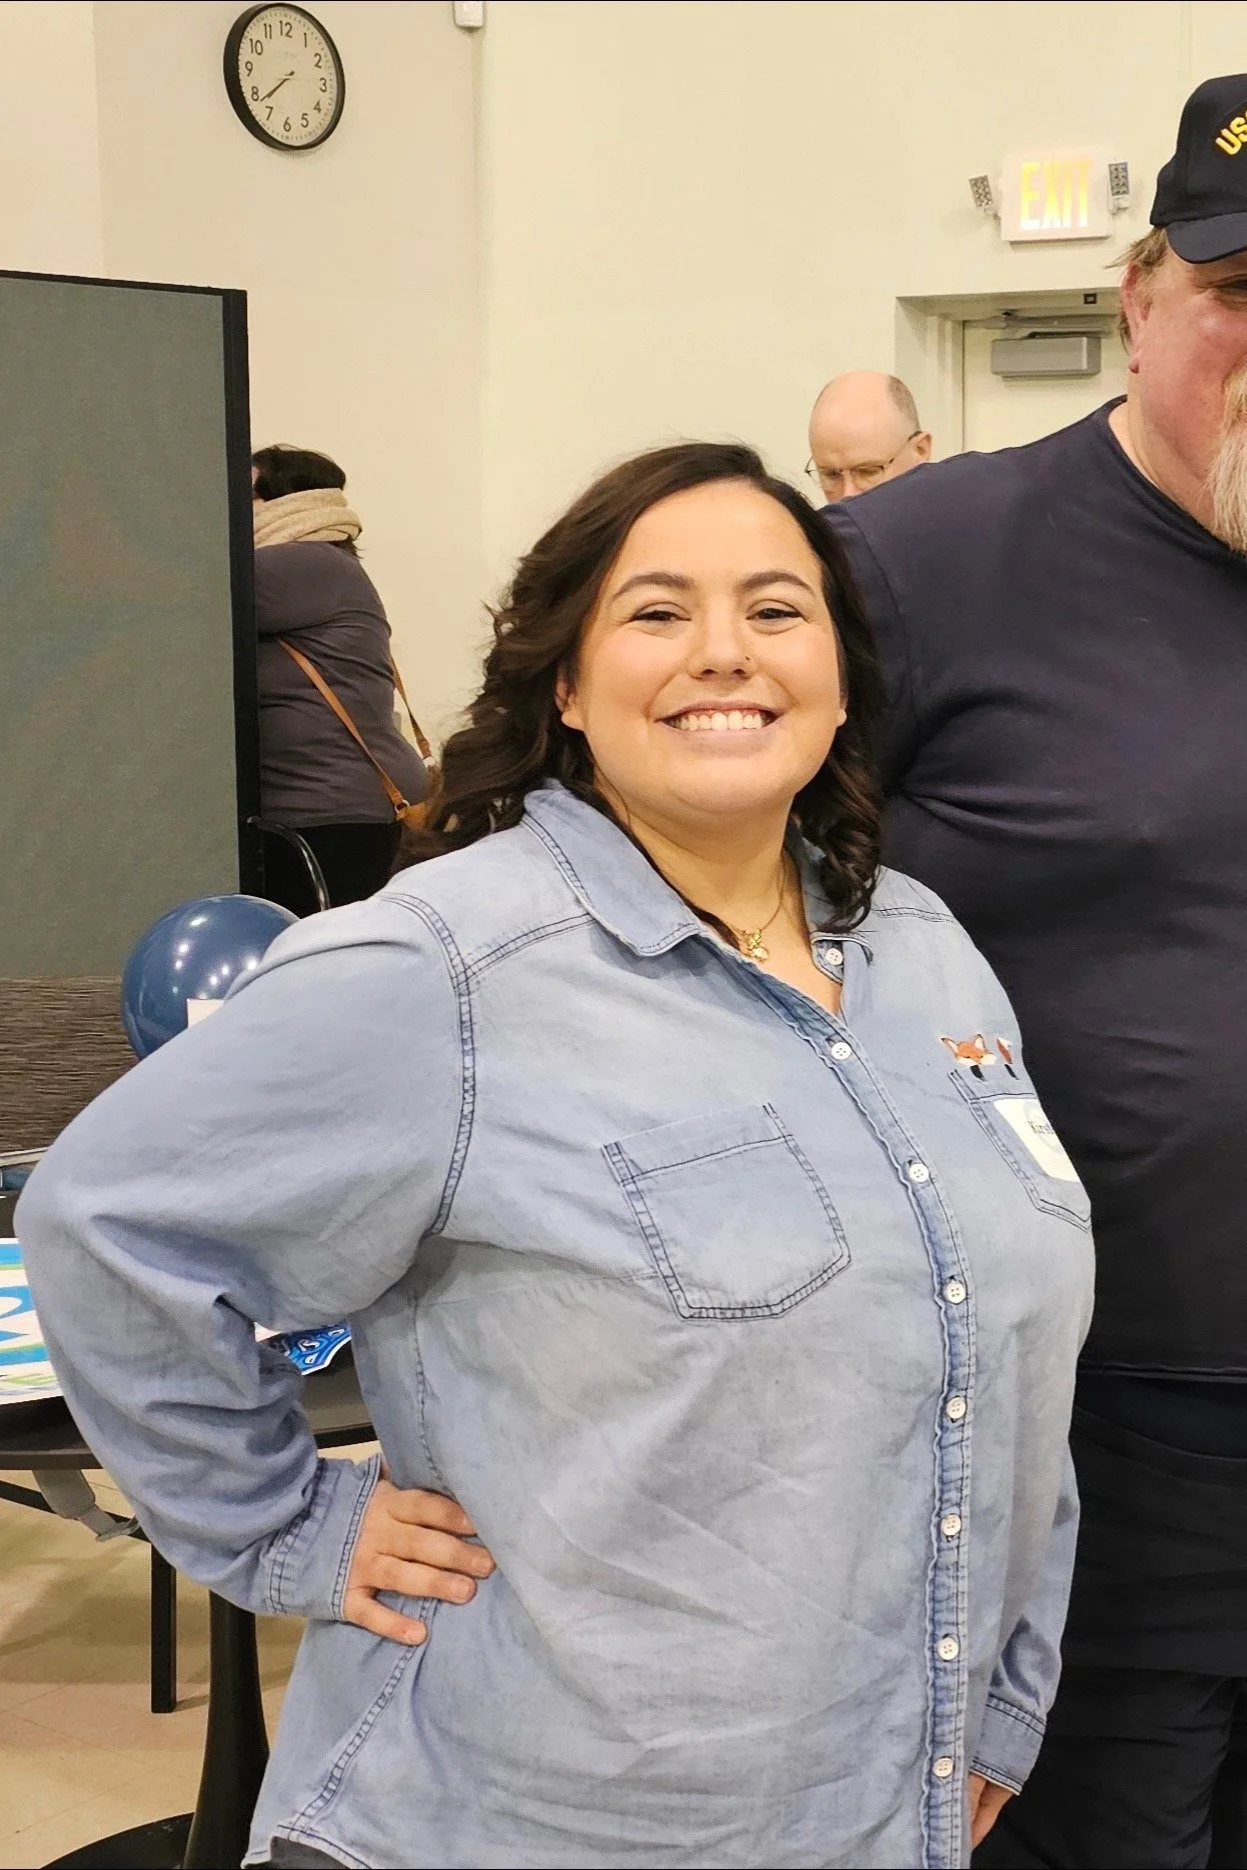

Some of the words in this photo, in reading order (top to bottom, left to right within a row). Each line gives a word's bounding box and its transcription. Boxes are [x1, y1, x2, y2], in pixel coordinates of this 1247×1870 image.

[263, 23, 272, 40] 11
[279, 20, 293, 38] 12
[249, 38, 263, 56] 10
[303, 32, 308, 48] 1
[314, 52, 322, 69] 2
[245, 61, 253, 77] 9
[319, 77, 327, 92] 3
[251, 86, 259, 102] 8
[265, 106, 274, 121] 7
[313, 100, 322, 113] 4
[283, 117, 291, 132] 6
[300, 113, 309, 128] 5
[1020, 160, 1092, 230] EXIT
